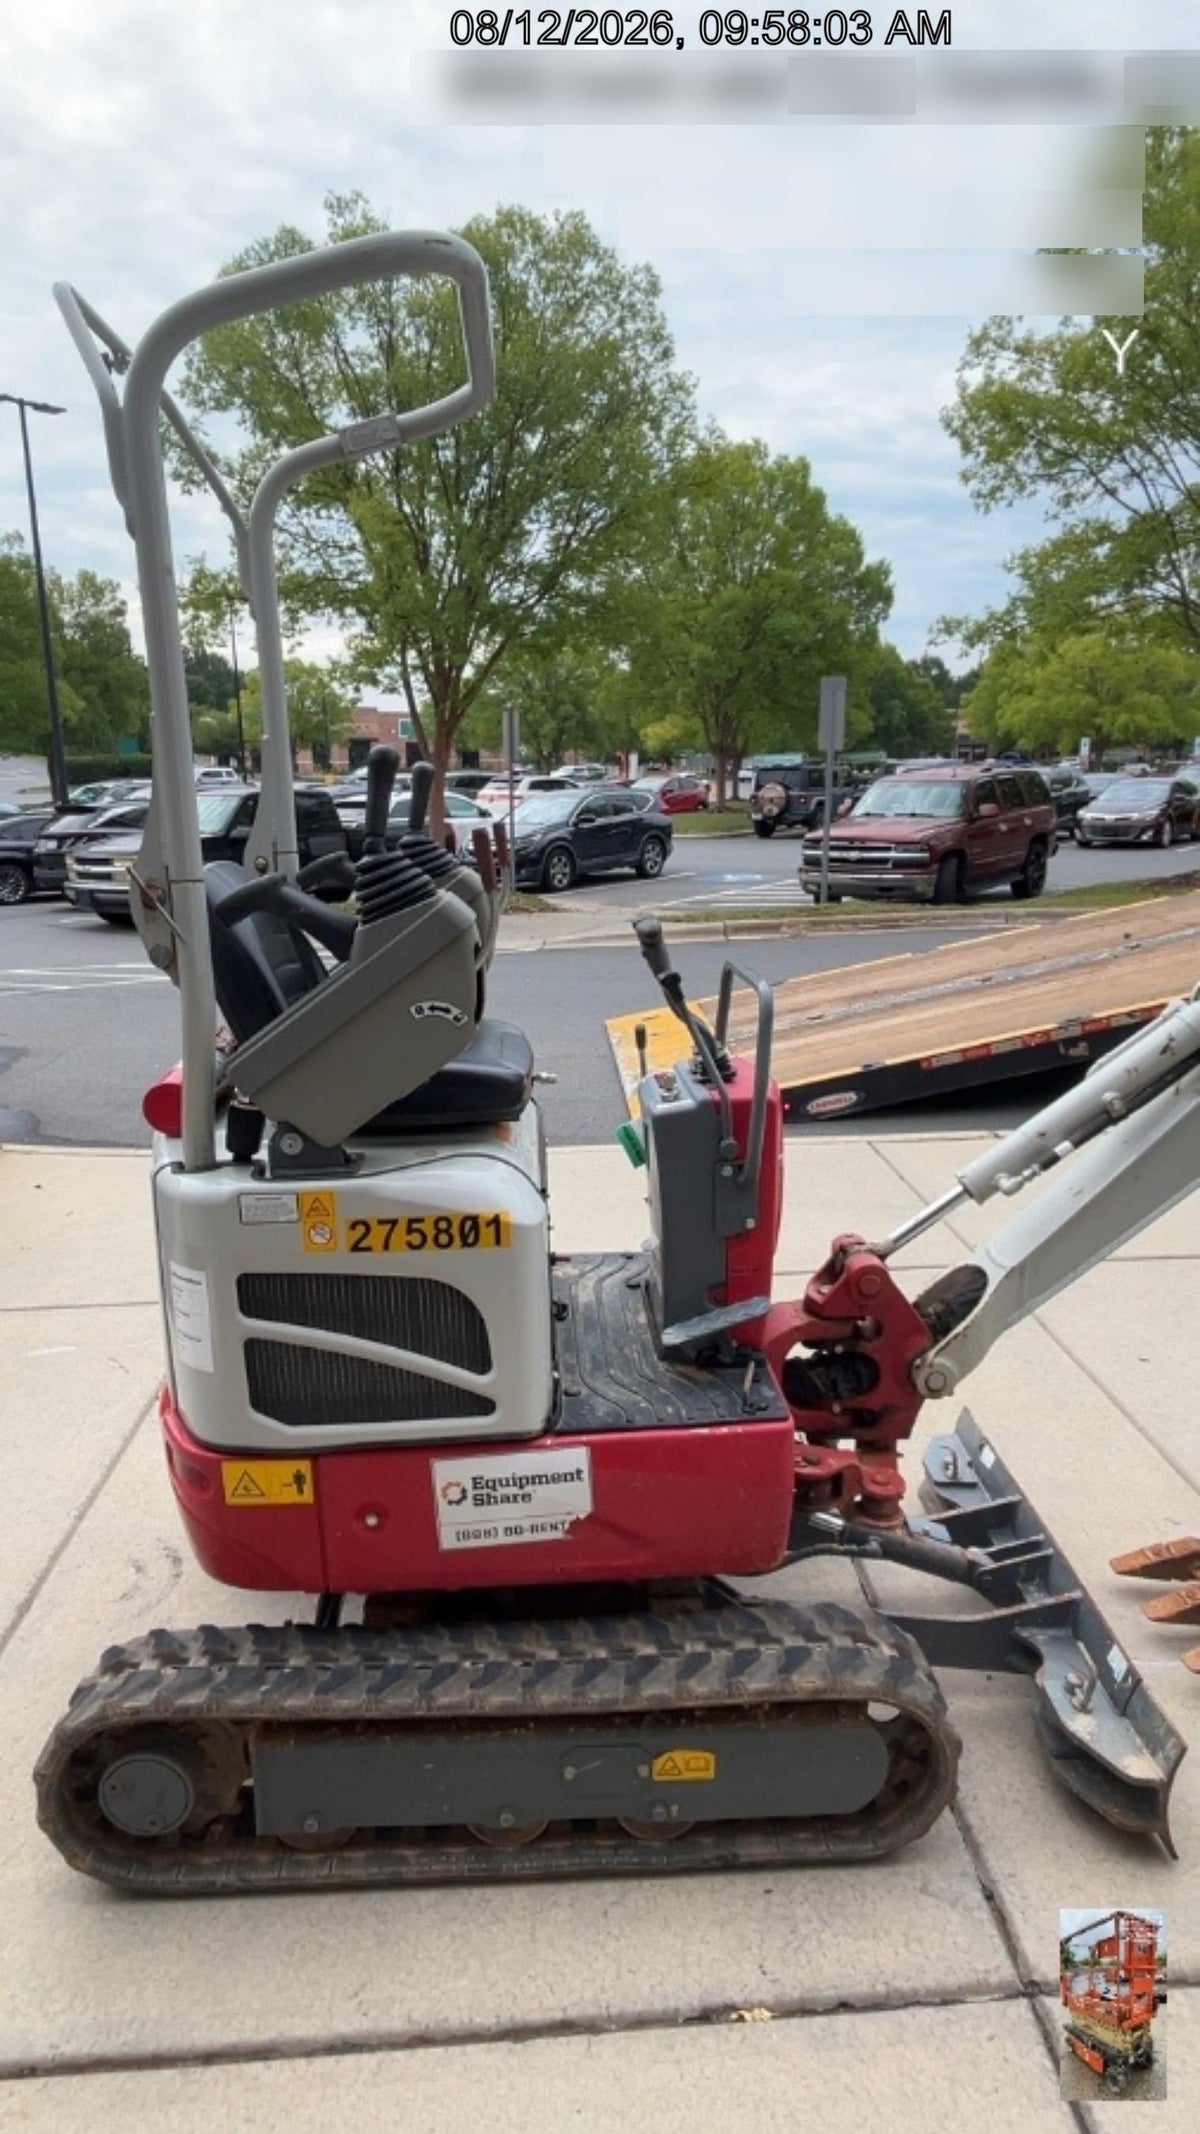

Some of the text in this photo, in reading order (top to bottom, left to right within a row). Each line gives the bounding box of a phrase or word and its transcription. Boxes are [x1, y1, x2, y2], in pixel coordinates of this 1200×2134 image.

[349, 1214, 502, 1252] 275801
[471, 1468, 584, 1492] Equipment
[472, 1492, 532, 1507] Share
